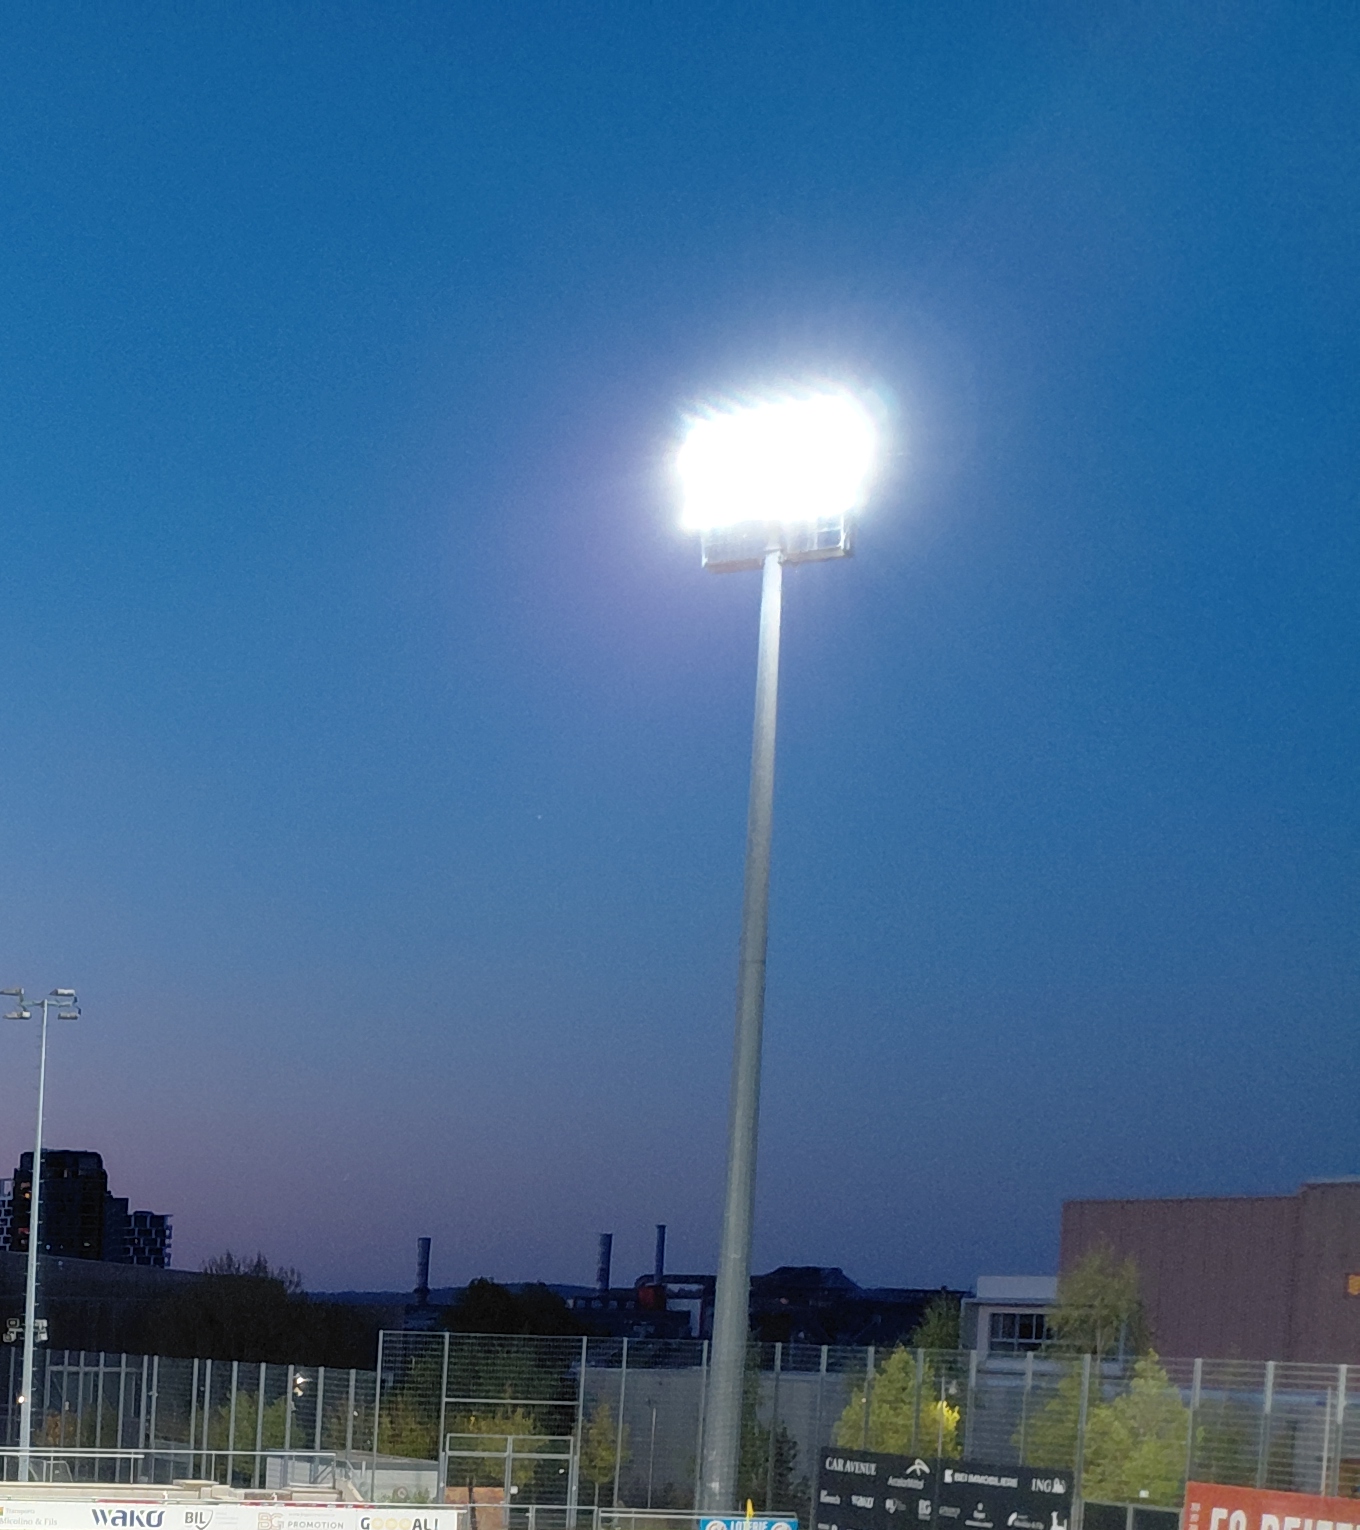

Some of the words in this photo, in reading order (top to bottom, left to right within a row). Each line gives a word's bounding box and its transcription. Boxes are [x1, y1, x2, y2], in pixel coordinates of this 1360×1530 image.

[1031, 1478, 1052, 1493] ING
[35, 1517, 43, 1525] &
[43, 1517, 58, 1526] Fils
[184, 1511, 207, 1525] BIL
[287, 1520, 345, 1530] PROMOTION
